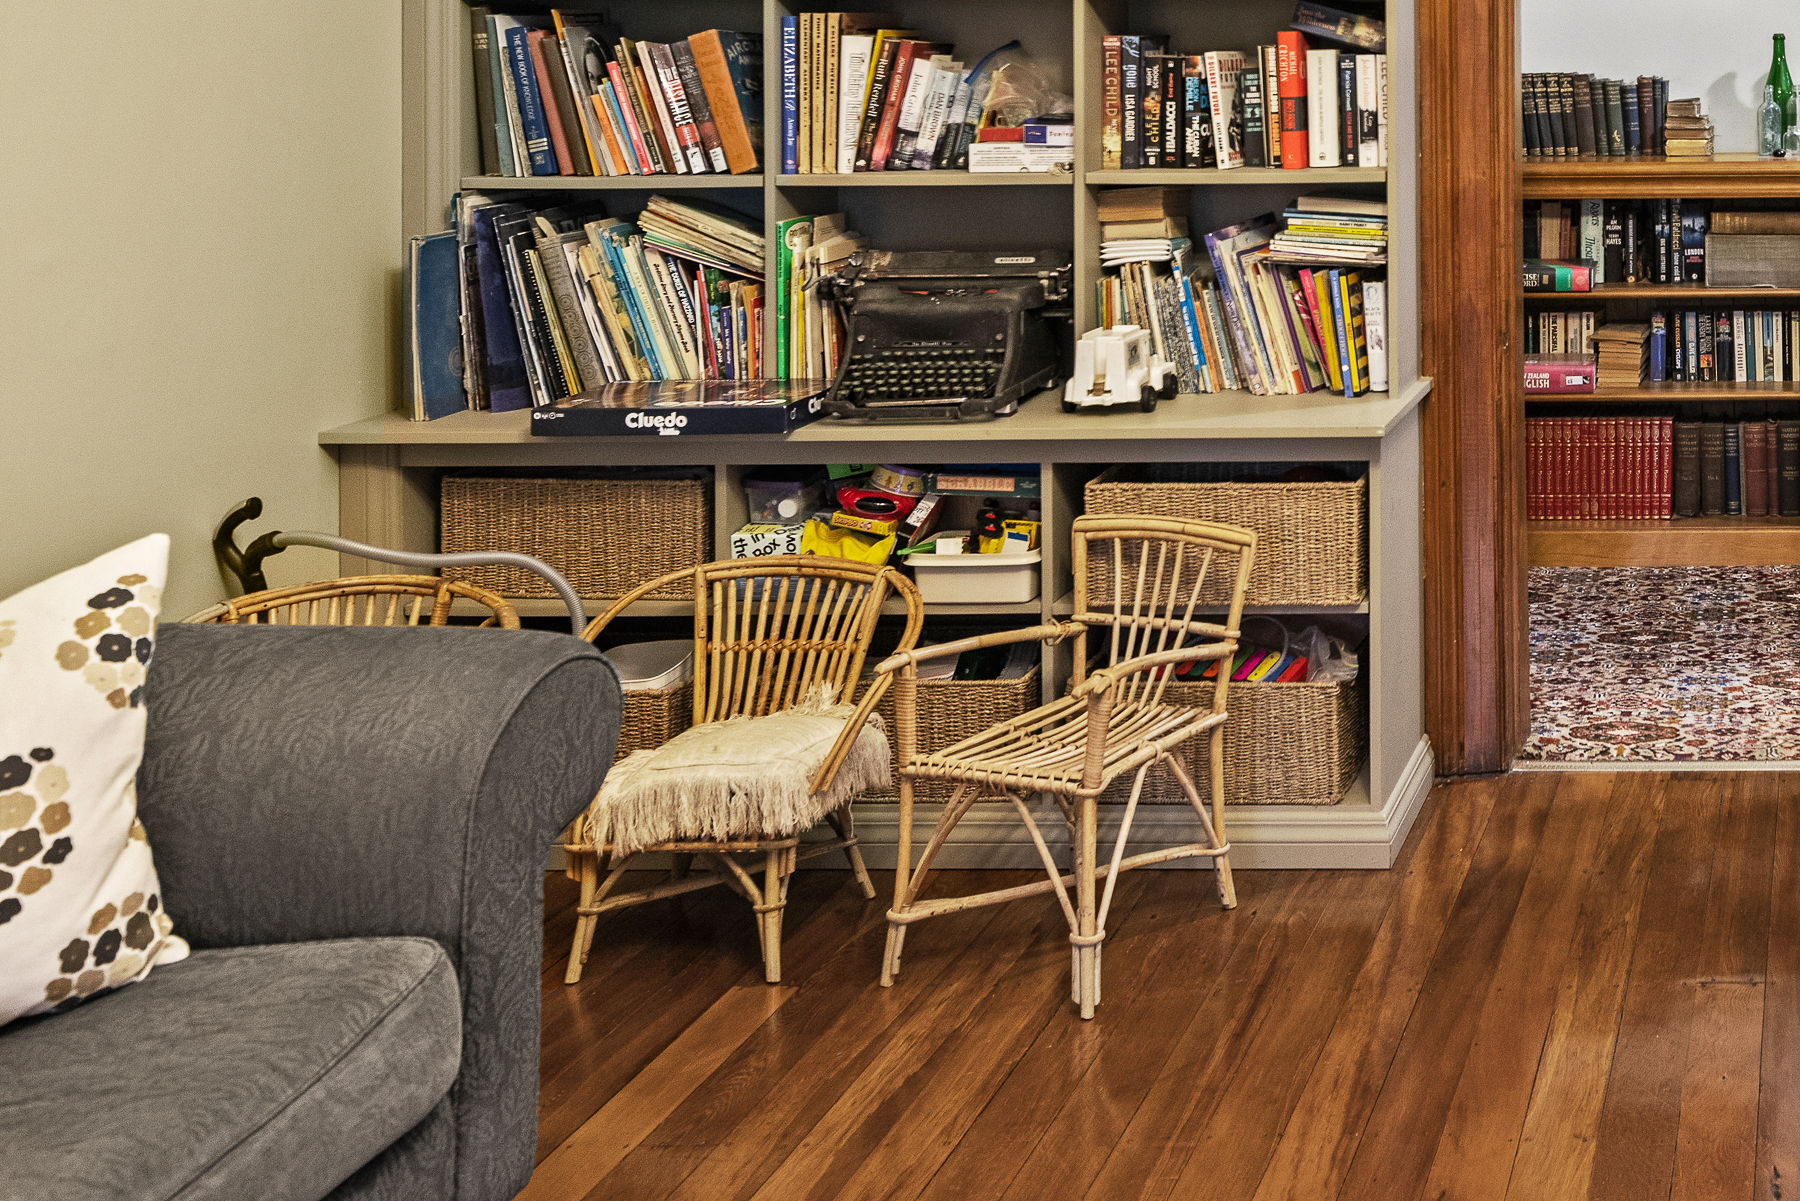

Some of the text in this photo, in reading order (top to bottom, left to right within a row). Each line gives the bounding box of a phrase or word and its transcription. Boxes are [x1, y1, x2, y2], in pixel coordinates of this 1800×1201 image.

[785, 26, 797, 103] ELIZABETH
[867, 58, 890, 118] Ruth Rendell
[1105, 50, 1117, 115] LEE CHILD
[1279, 43, 1288, 81] CRICHTON
[1125, 62, 1138, 142] gone LISA GARDNER
[1165, 99, 1177, 152] BALDACCI
[625, 411, 688, 429] Cluedo
[936, 476, 1014, 492] SCRABBLE
